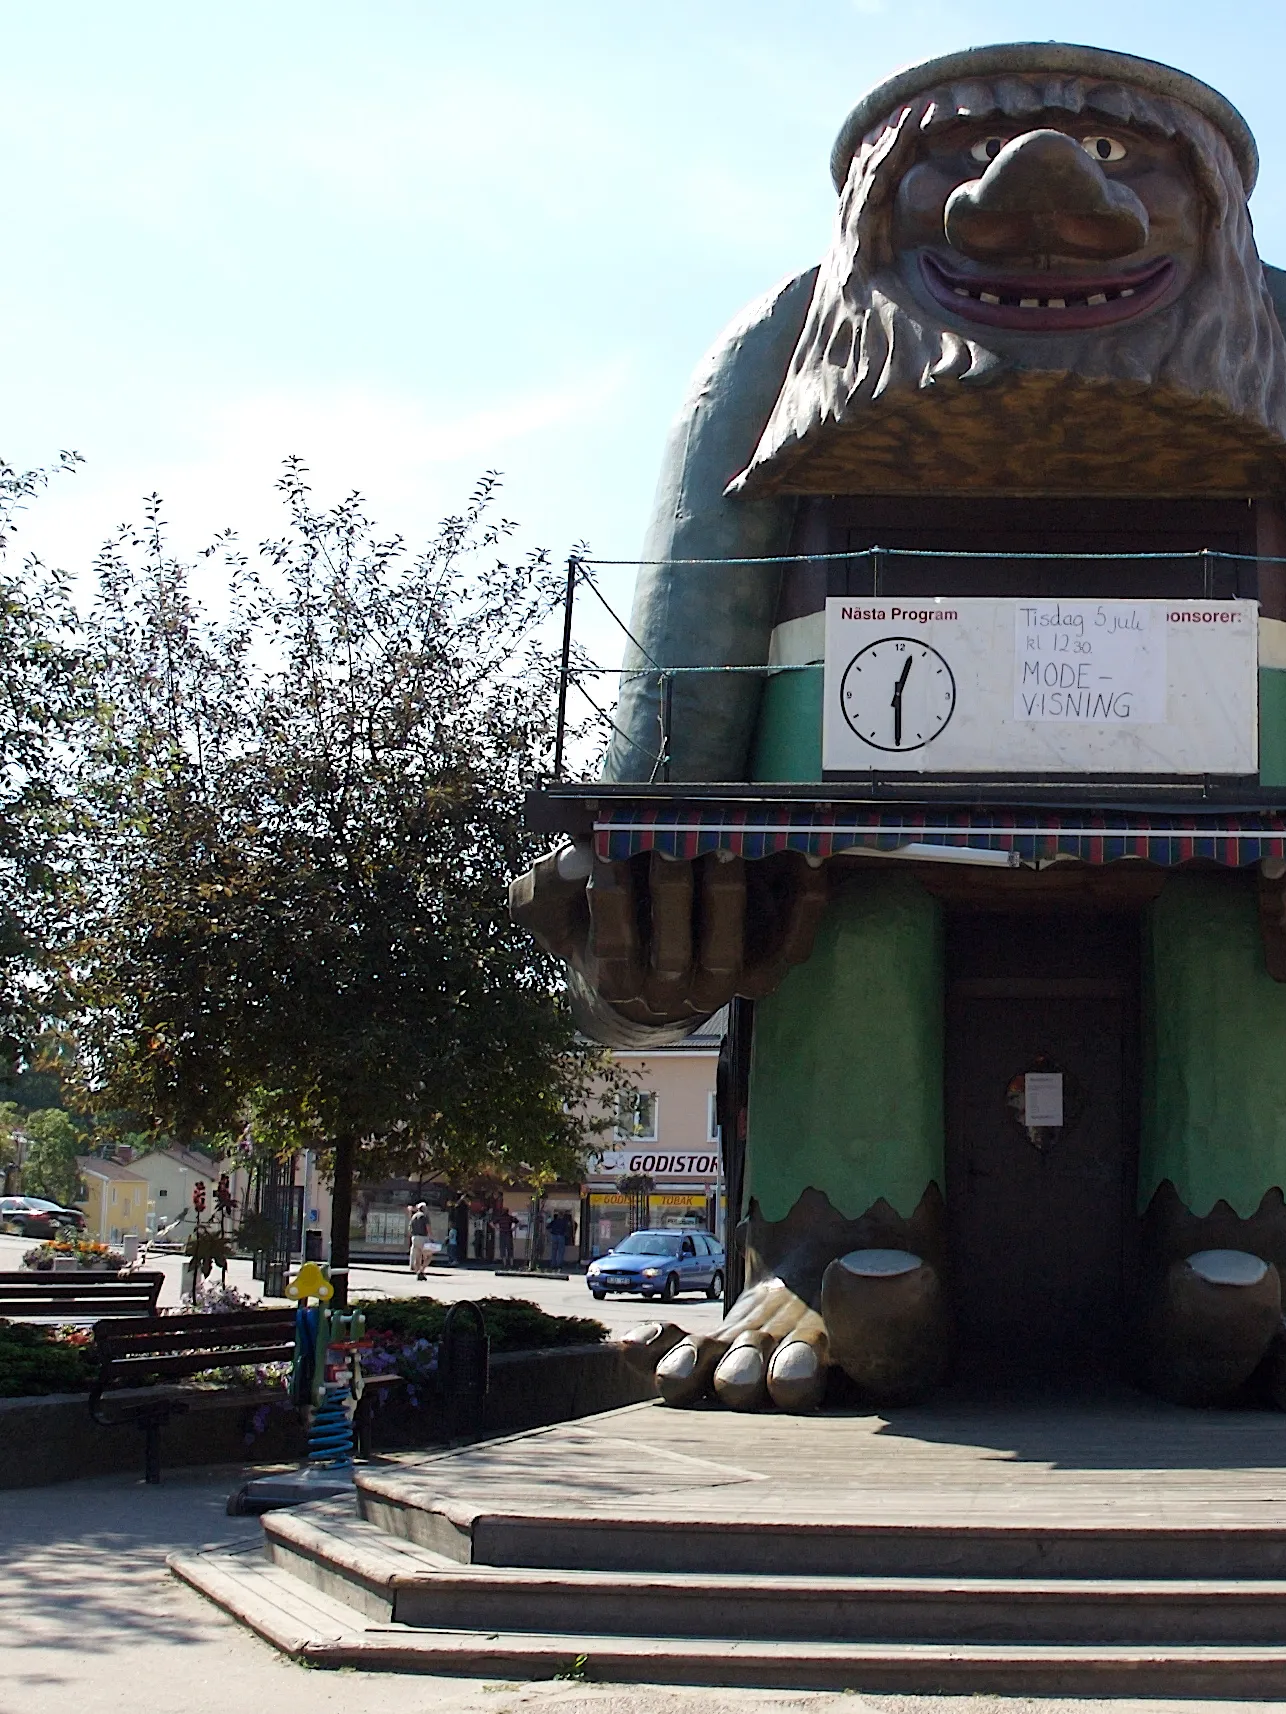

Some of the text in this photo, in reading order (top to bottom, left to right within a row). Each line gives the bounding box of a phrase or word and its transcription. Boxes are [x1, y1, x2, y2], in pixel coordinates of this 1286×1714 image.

[841, 606, 958, 624] Nästa Program
[1020, 603, 1145, 637] Tisdag 5 juli
[895, 643, 906, 652] 12
[1026, 634, 1041, 651] kl
[846, 691, 853, 699] 9
[945, 692, 951, 700] 3
[1022, 691, 1134, 718] VISNING
[661, 1195, 694, 1206] TOBAK
